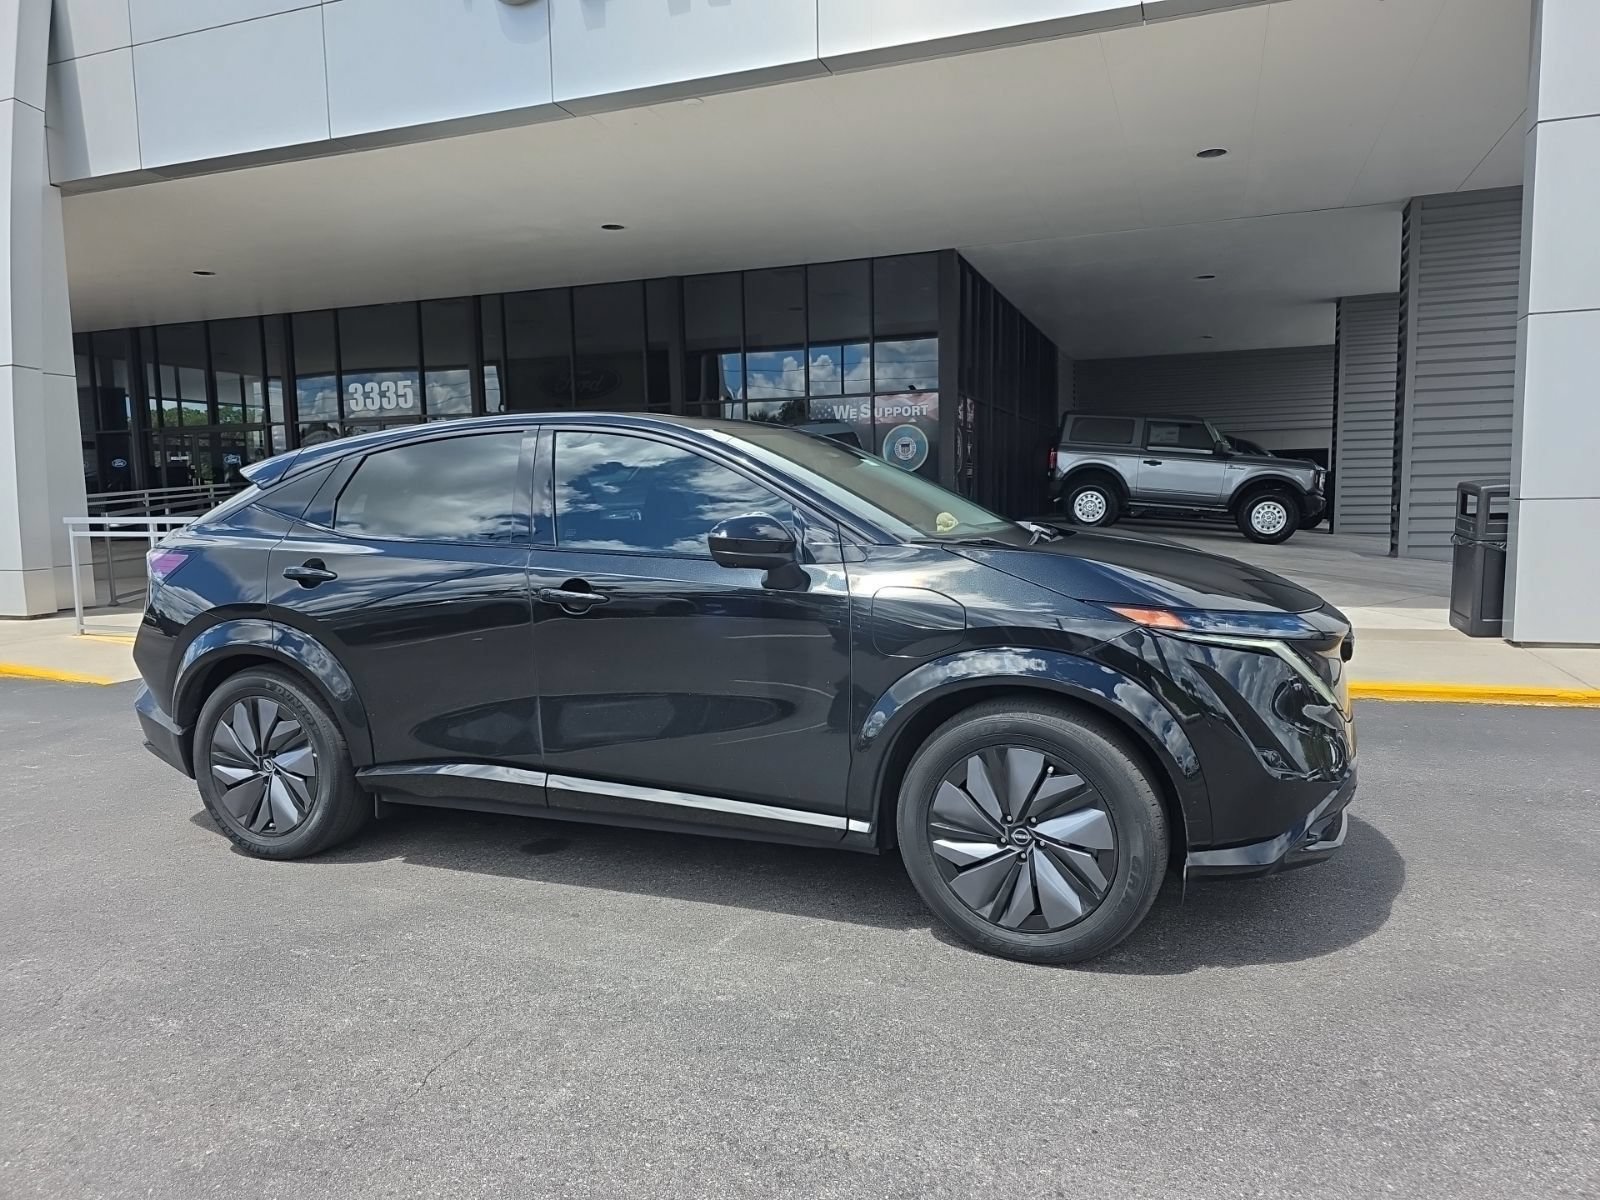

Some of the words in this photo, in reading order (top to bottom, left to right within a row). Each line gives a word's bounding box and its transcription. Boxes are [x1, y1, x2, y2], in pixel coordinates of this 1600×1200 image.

[349, 380, 413, 411] 3335
[833, 405, 857, 420] WE
[860, 403, 929, 419] SUPPORT
